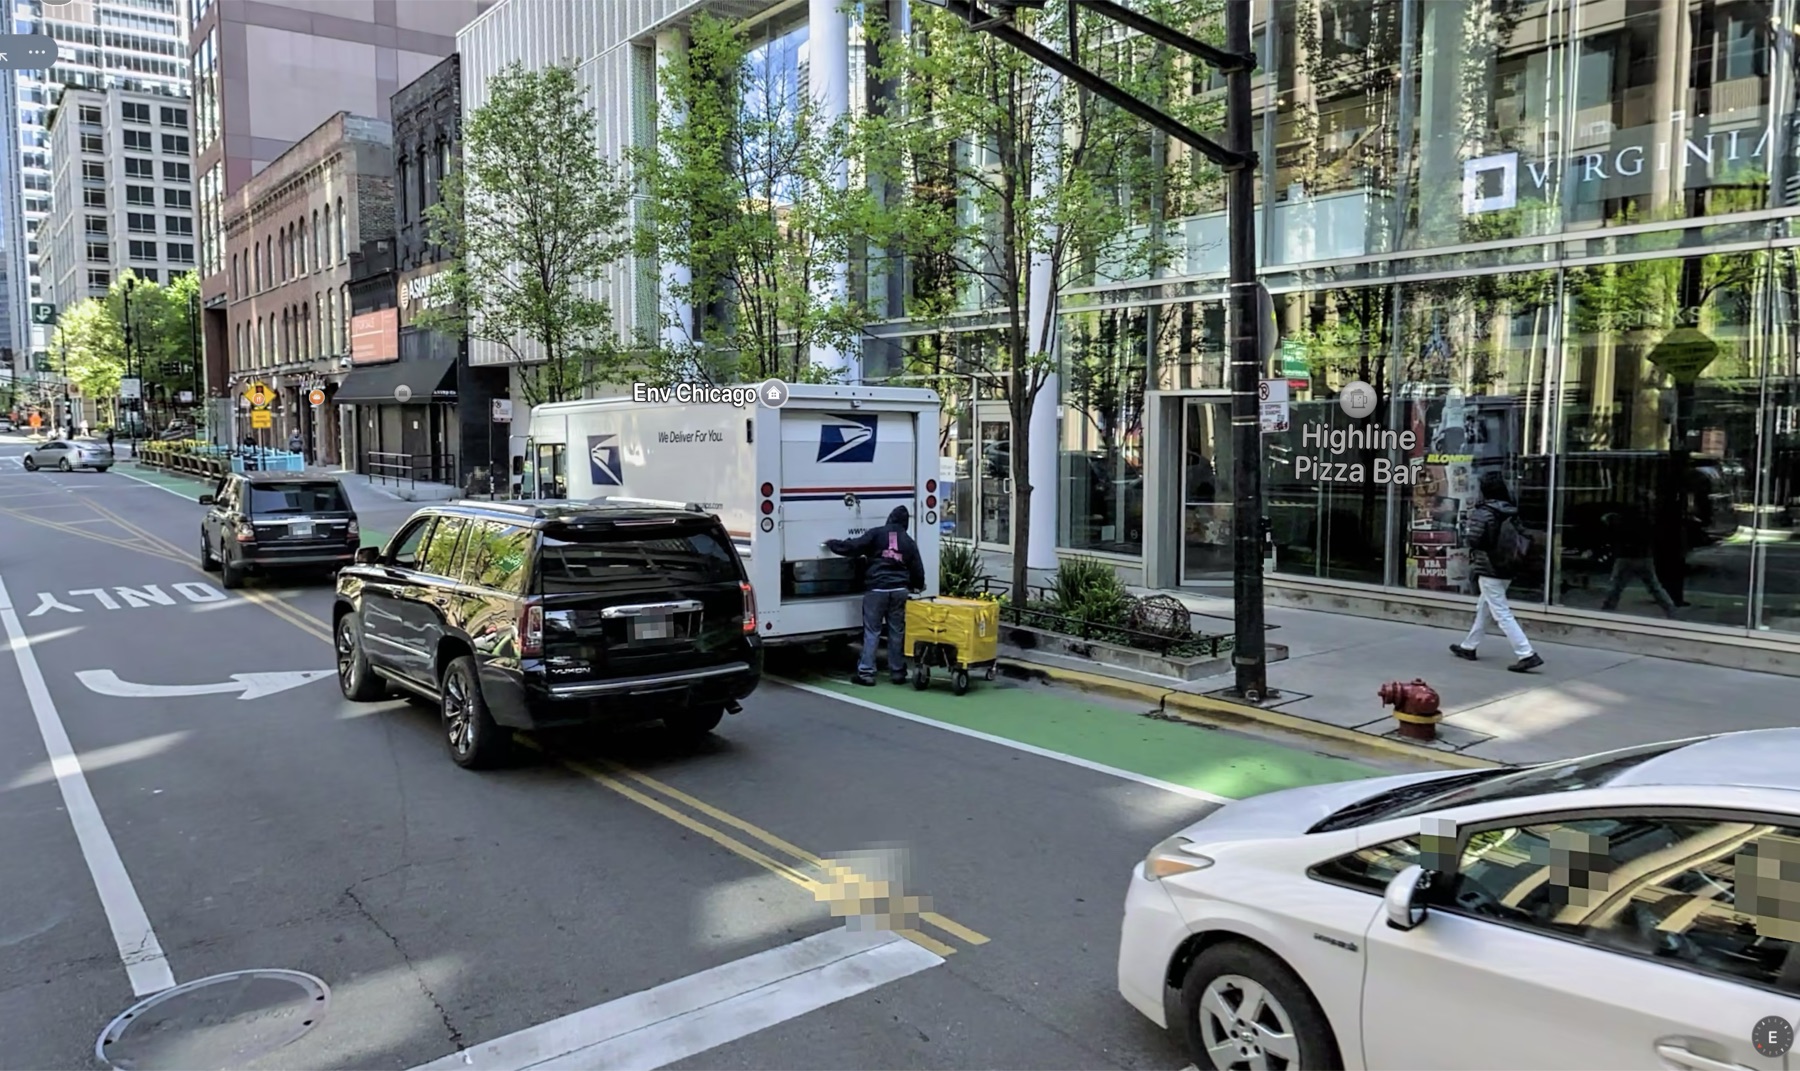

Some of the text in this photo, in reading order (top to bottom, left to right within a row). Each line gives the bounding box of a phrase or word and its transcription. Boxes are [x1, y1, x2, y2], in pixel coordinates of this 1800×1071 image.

[658, 431, 669, 443] We
[669, 431, 694, 443] Deliver
[694, 430, 708, 442] For
[26, 582, 228, 617] ONLY
[551, 667, 591, 675] YUKON
